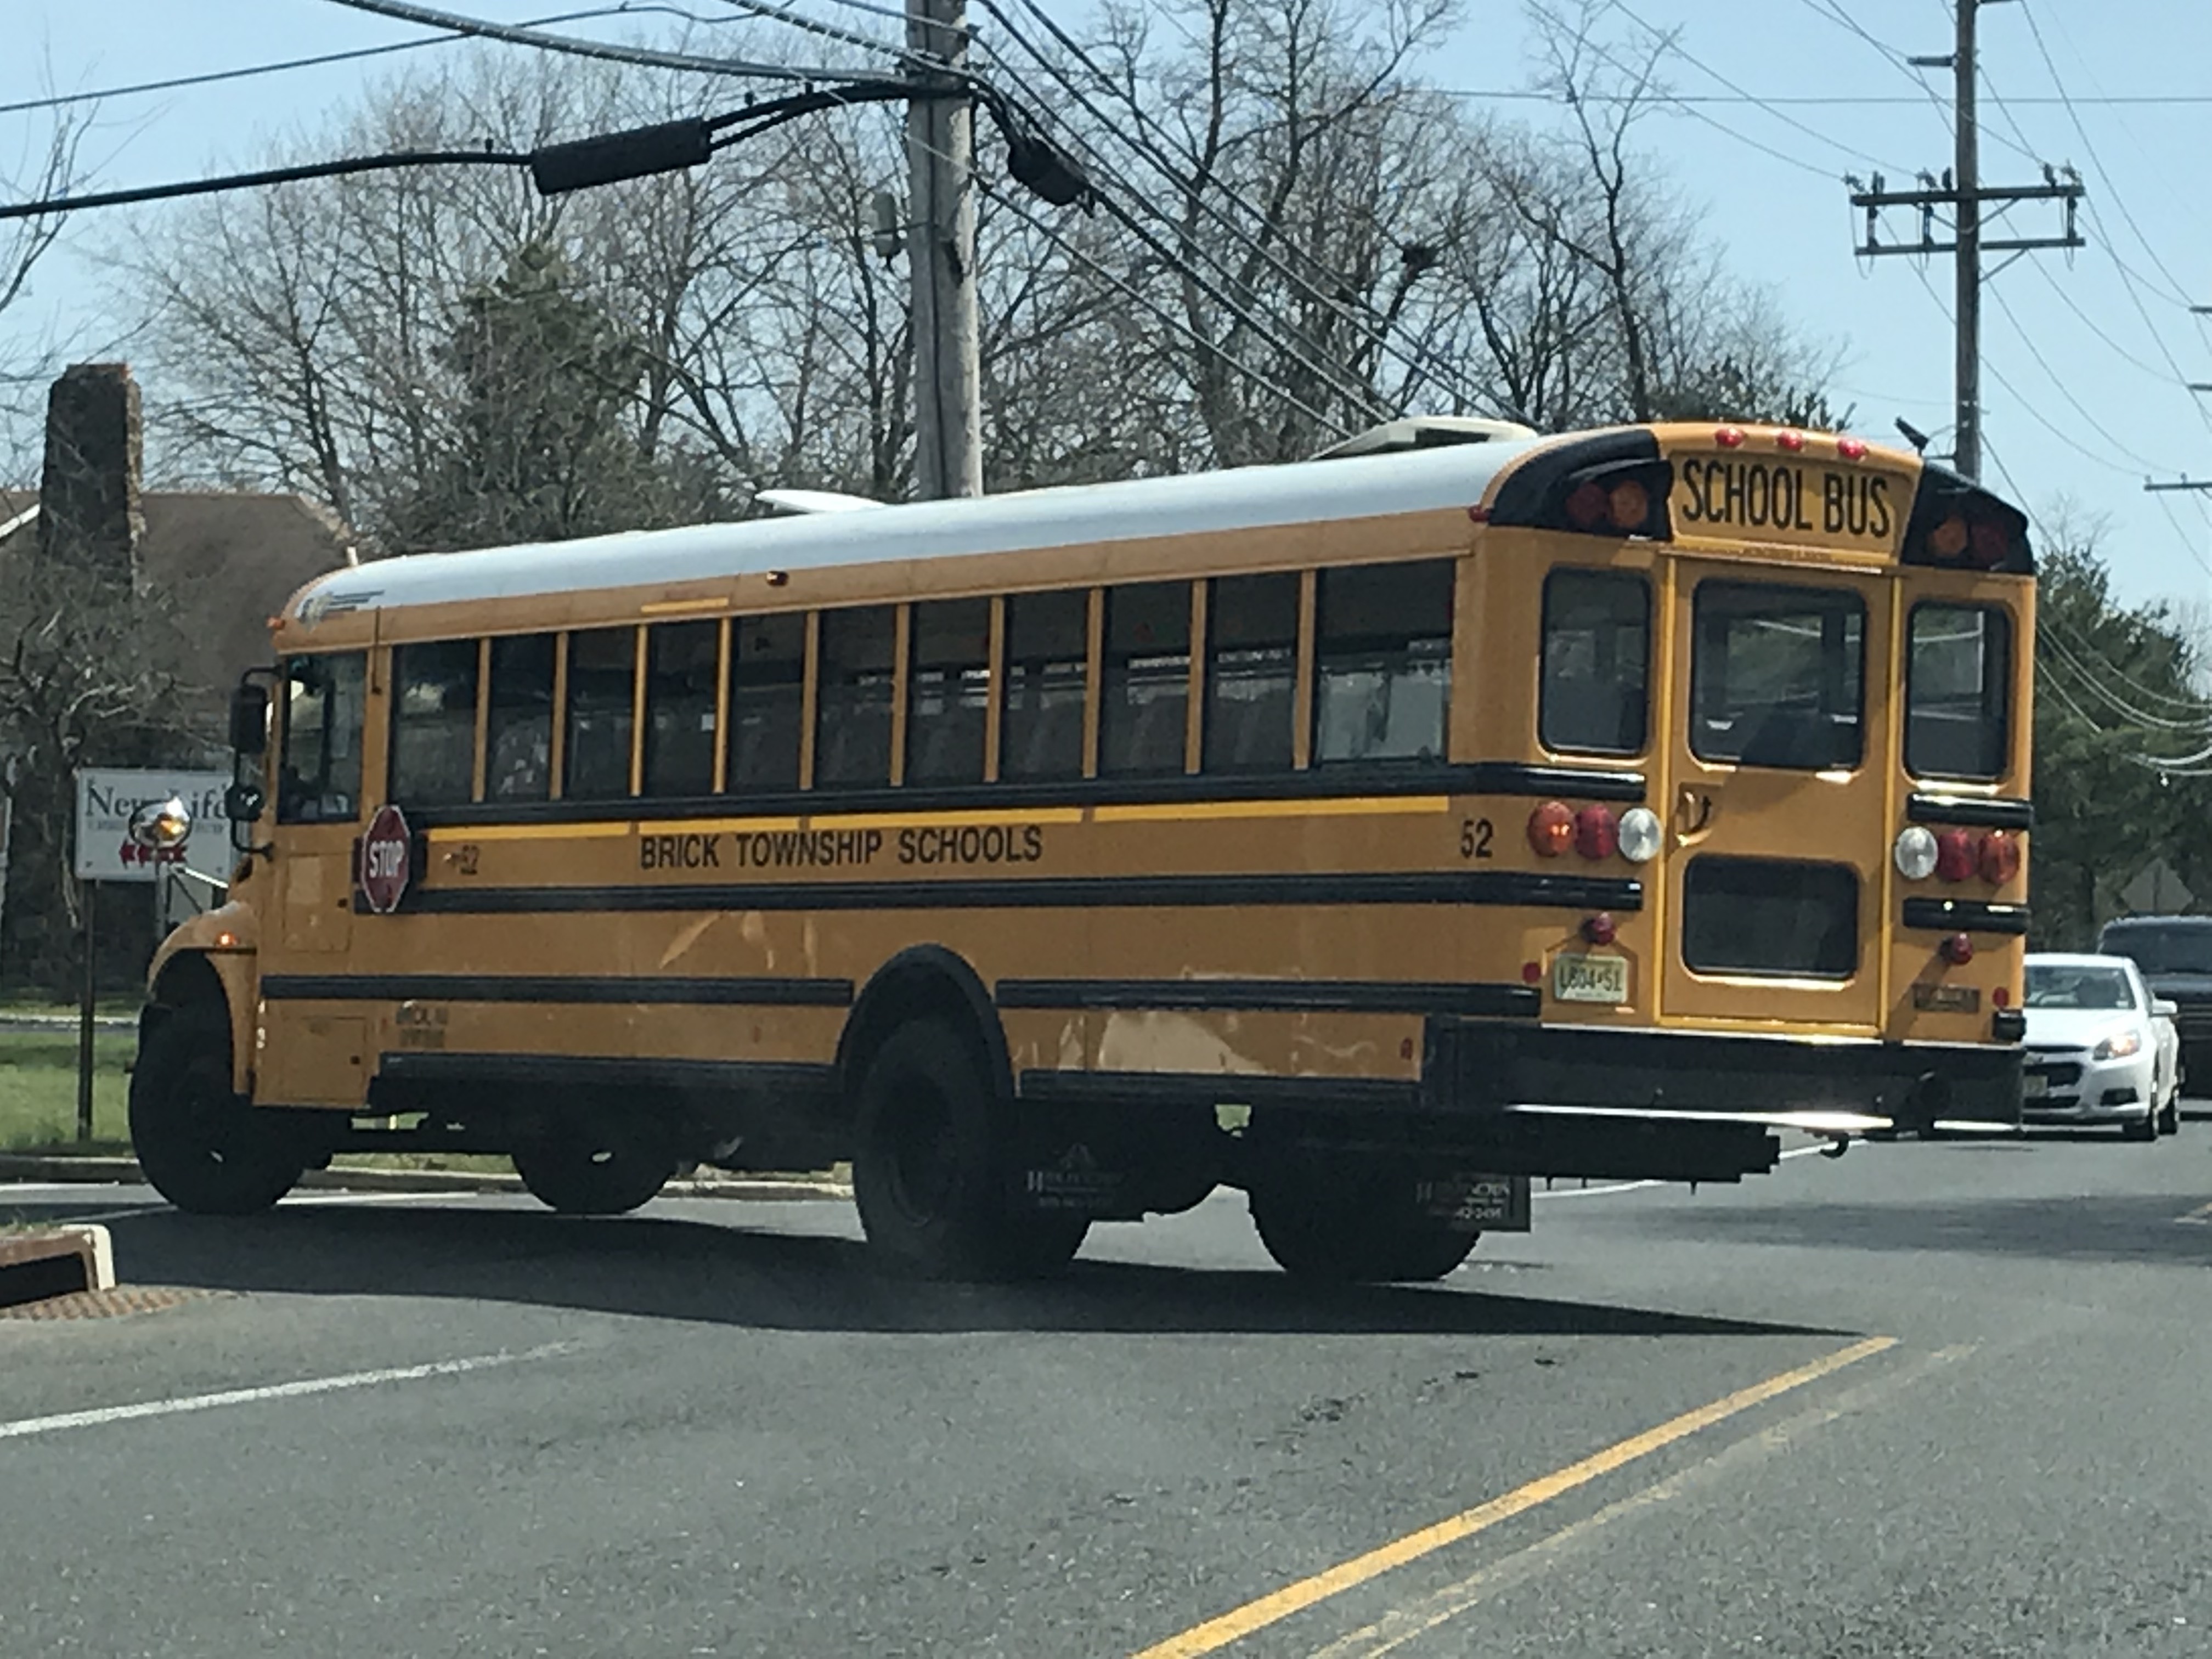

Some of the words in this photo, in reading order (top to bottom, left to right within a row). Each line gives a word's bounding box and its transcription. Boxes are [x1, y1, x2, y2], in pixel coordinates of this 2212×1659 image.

[1681, 458, 1813, 531] SCHOOL
[1824, 472, 1890, 538] BUS
[369, 840, 405, 878] STOP
[640, 833, 721, 869] BRICK
[736, 829, 882, 868] TOWNSHIP
[898, 824, 1042, 865] SCHOOLS
[1461, 817, 1493, 859] 52
